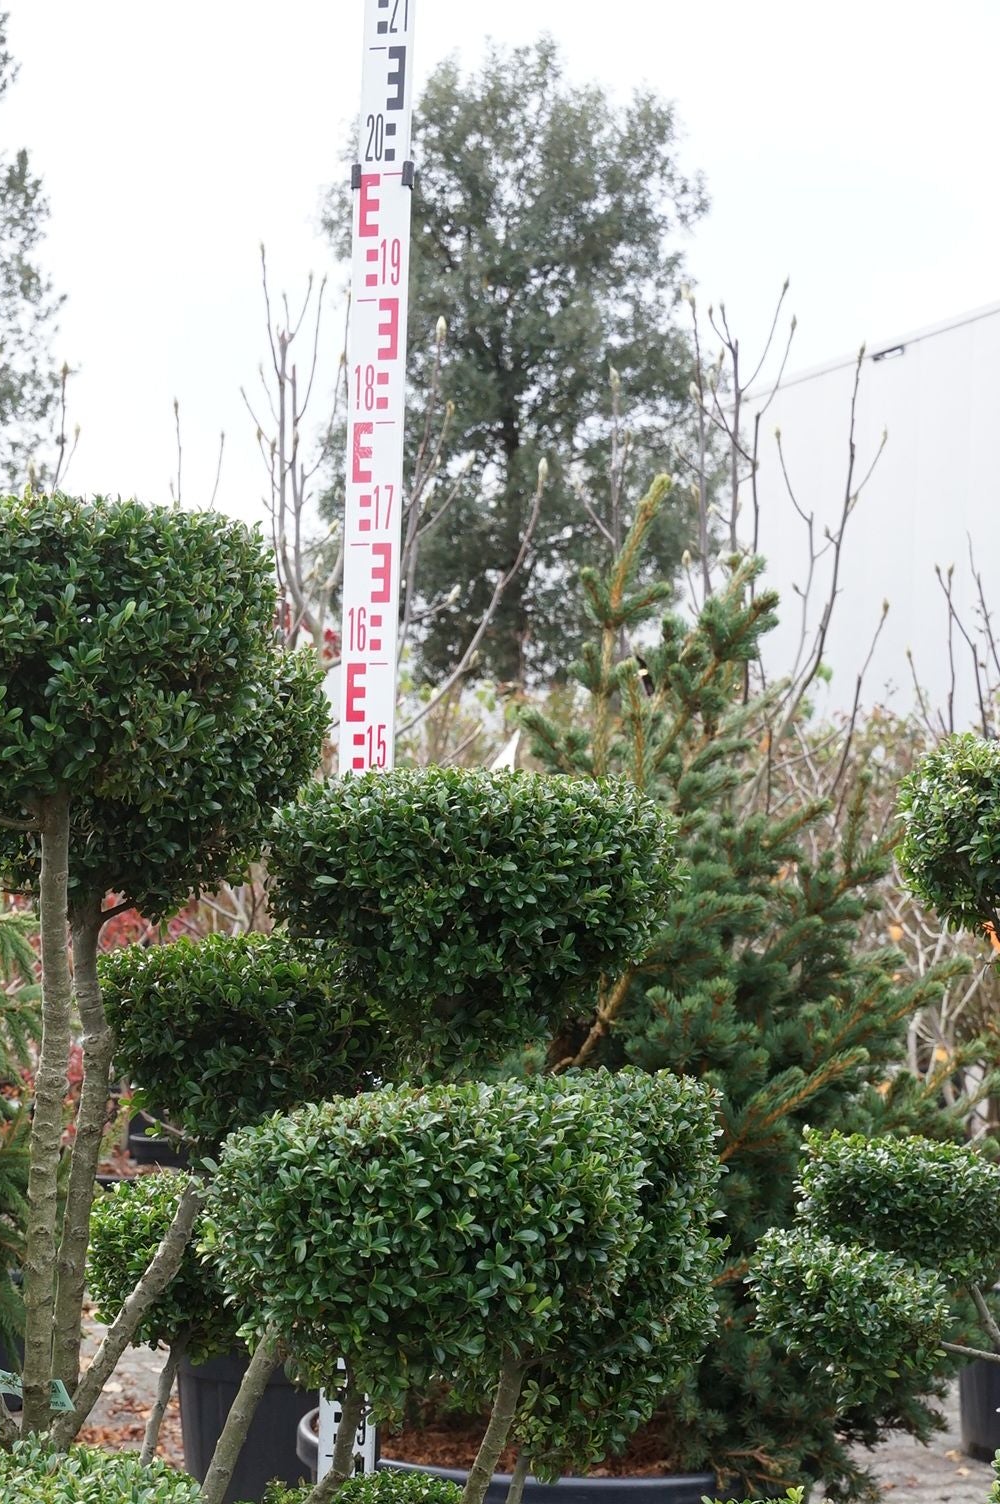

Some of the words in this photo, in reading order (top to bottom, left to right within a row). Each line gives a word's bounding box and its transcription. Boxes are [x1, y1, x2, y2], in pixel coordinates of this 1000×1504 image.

[389, 0, 408, 33] 21
[365, 113, 384, 162] 20
[380, 238, 401, 286] 19
[354, 364, 375, 412] 18
[373, 484, 394, 530] 17
[348, 606, 367, 652] 16
[366, 724, 387, 769] 15
